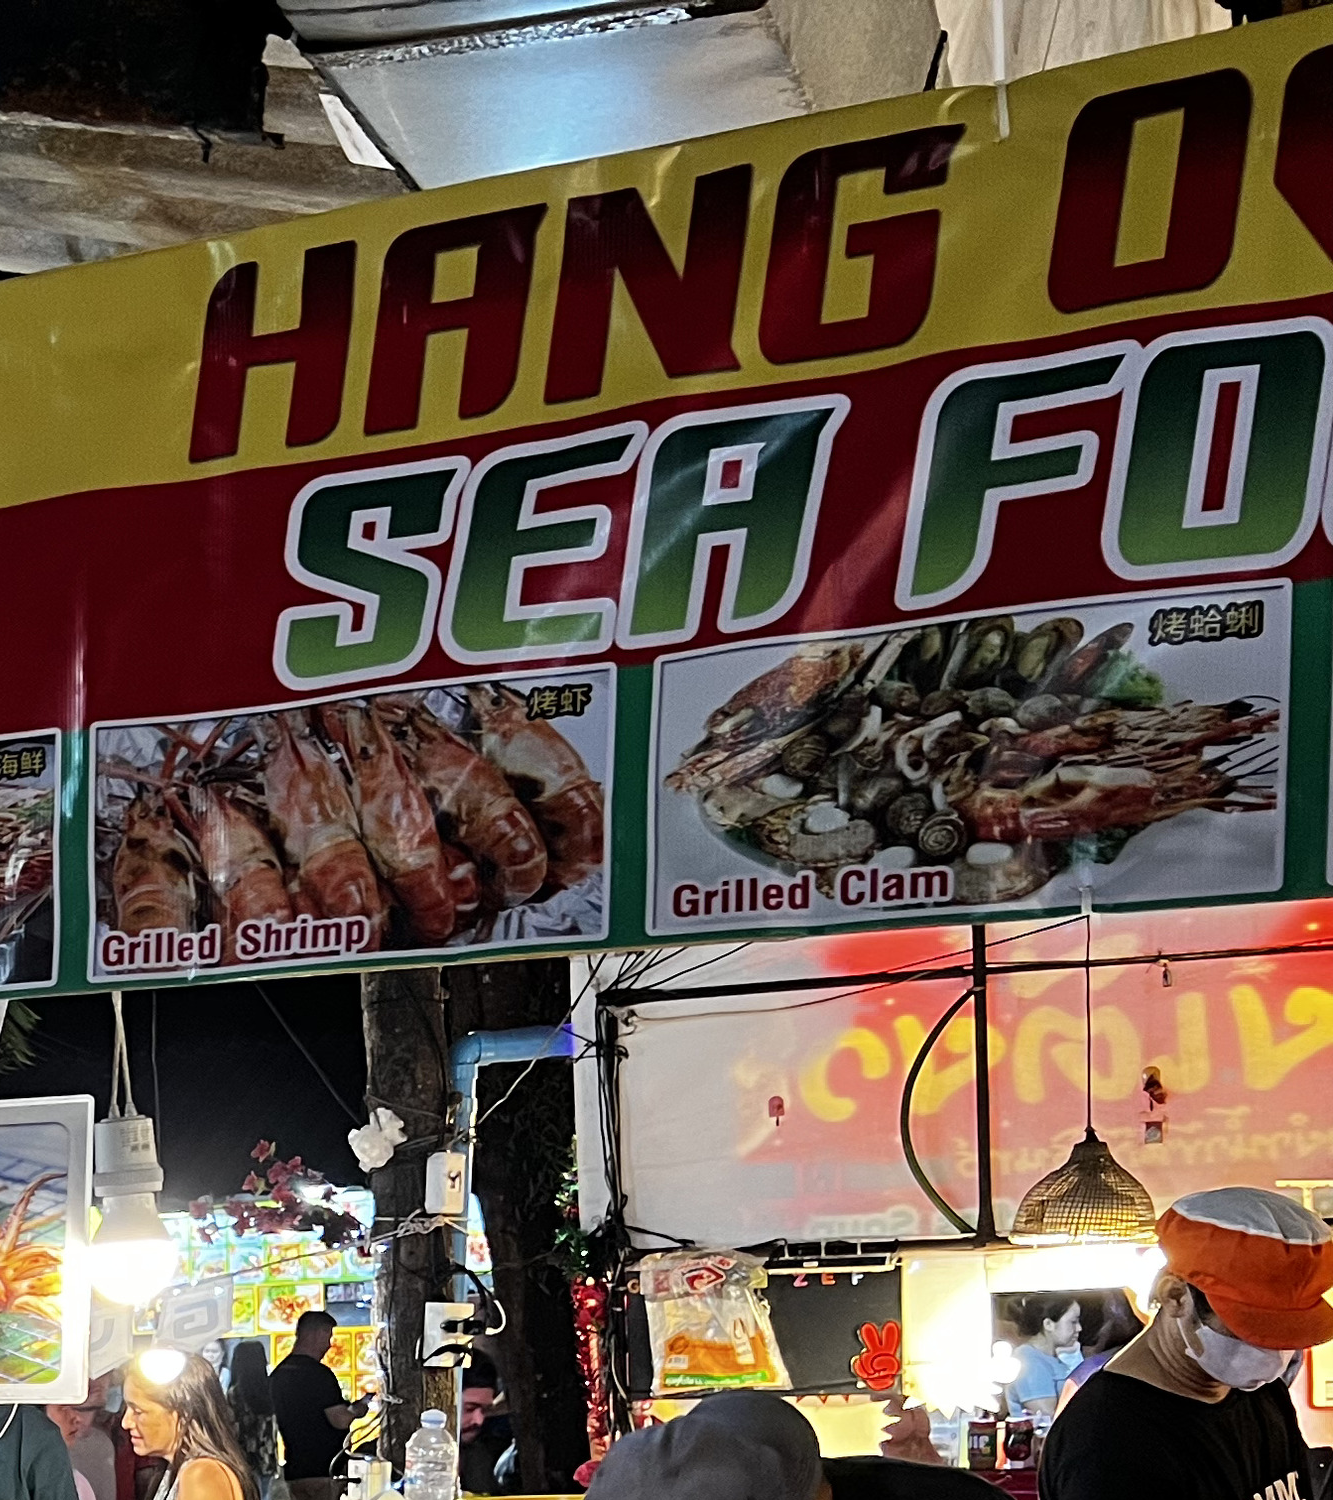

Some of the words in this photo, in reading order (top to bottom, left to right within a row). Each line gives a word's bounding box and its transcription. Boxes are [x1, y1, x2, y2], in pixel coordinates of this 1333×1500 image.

[191, 122, 966, 463] HANG
[274, 394, 851, 688] SEA
[893, 316, 1333, 610] FO
[529, 686, 592, 718] 烤虾
[673, 873, 812, 918] Grilled
[840, 866, 950, 904] Clam
[101, 929, 218, 968] Grilled
[239, 918, 368, 960] Shrimp
